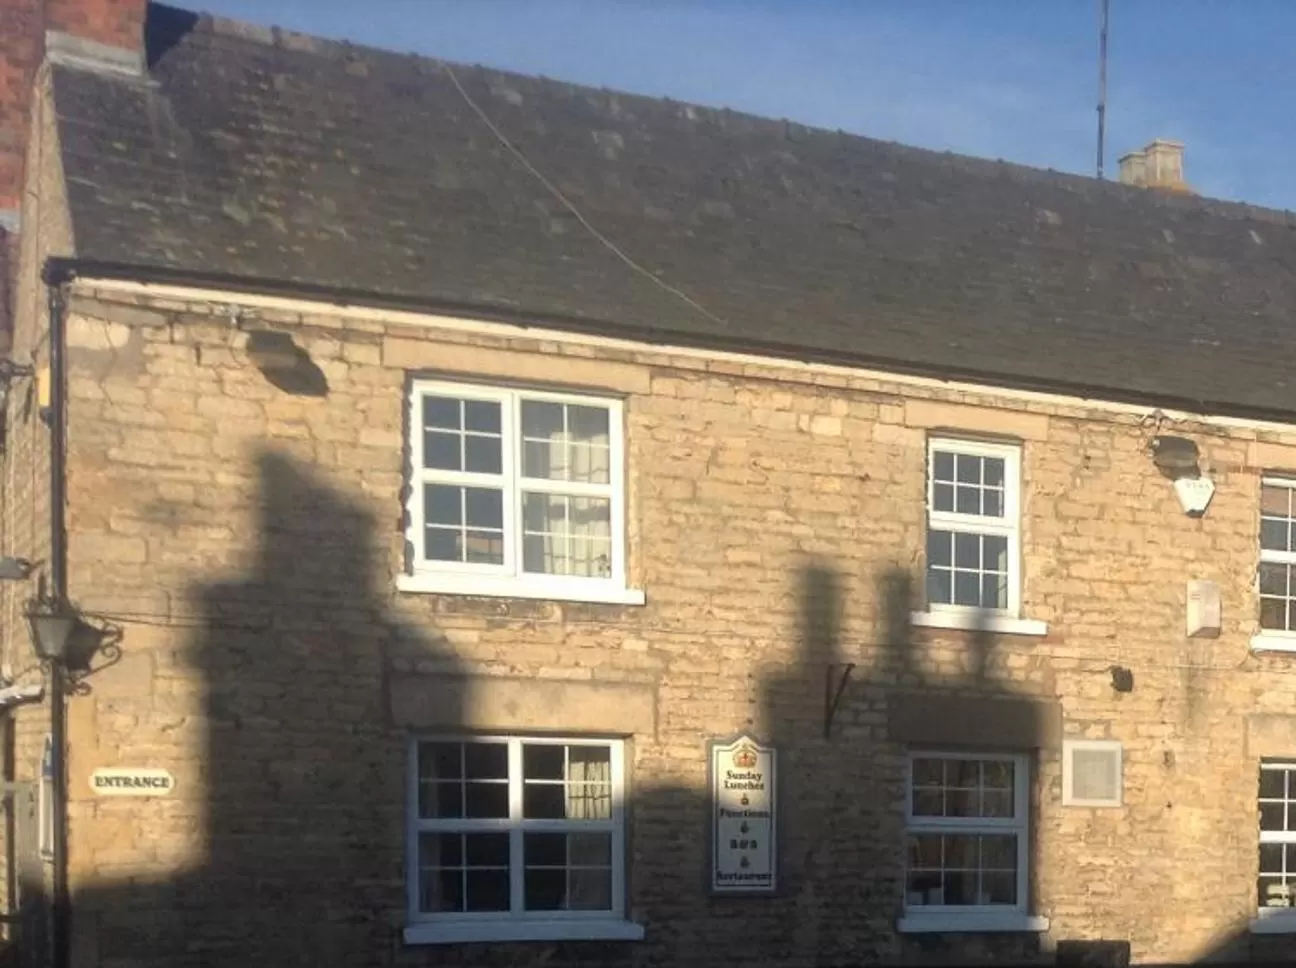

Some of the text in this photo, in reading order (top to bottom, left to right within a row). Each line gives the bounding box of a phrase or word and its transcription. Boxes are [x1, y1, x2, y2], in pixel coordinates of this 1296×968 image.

[726, 770, 763, 781] Sunday
[95, 775, 169, 789] ENTRANCE
[724, 780, 765, 790] Lunches
